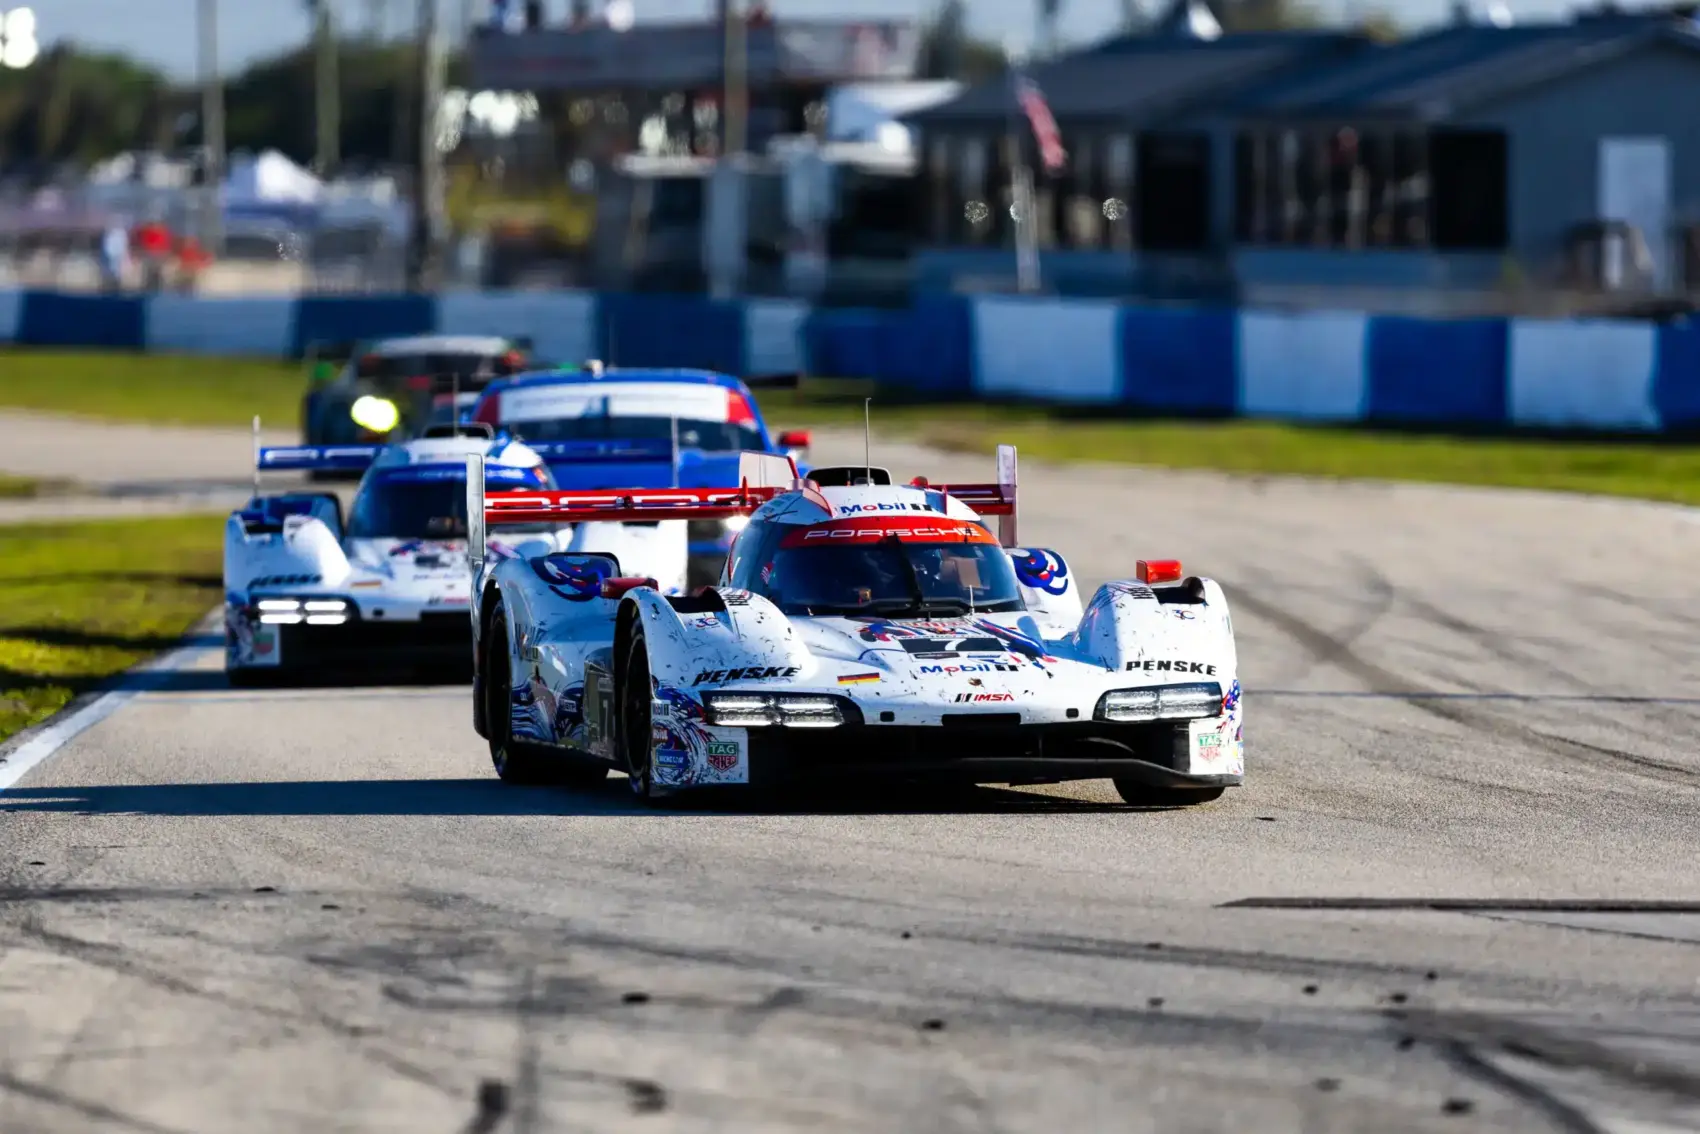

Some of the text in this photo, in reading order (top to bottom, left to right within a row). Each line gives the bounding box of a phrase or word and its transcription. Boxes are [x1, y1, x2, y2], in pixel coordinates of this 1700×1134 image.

[840, 502, 906, 514] Mobil
[804, 528, 982, 539] PORSCHE
[920, 664, 991, 674] Mobil
[1126, 660, 1217, 676] PENSKE
[692, 666, 801, 687] PENSKE
[973, 693, 1014, 701] IMSA
[709, 744, 735, 754] TAG
[708, 755, 736, 769] HEUER
